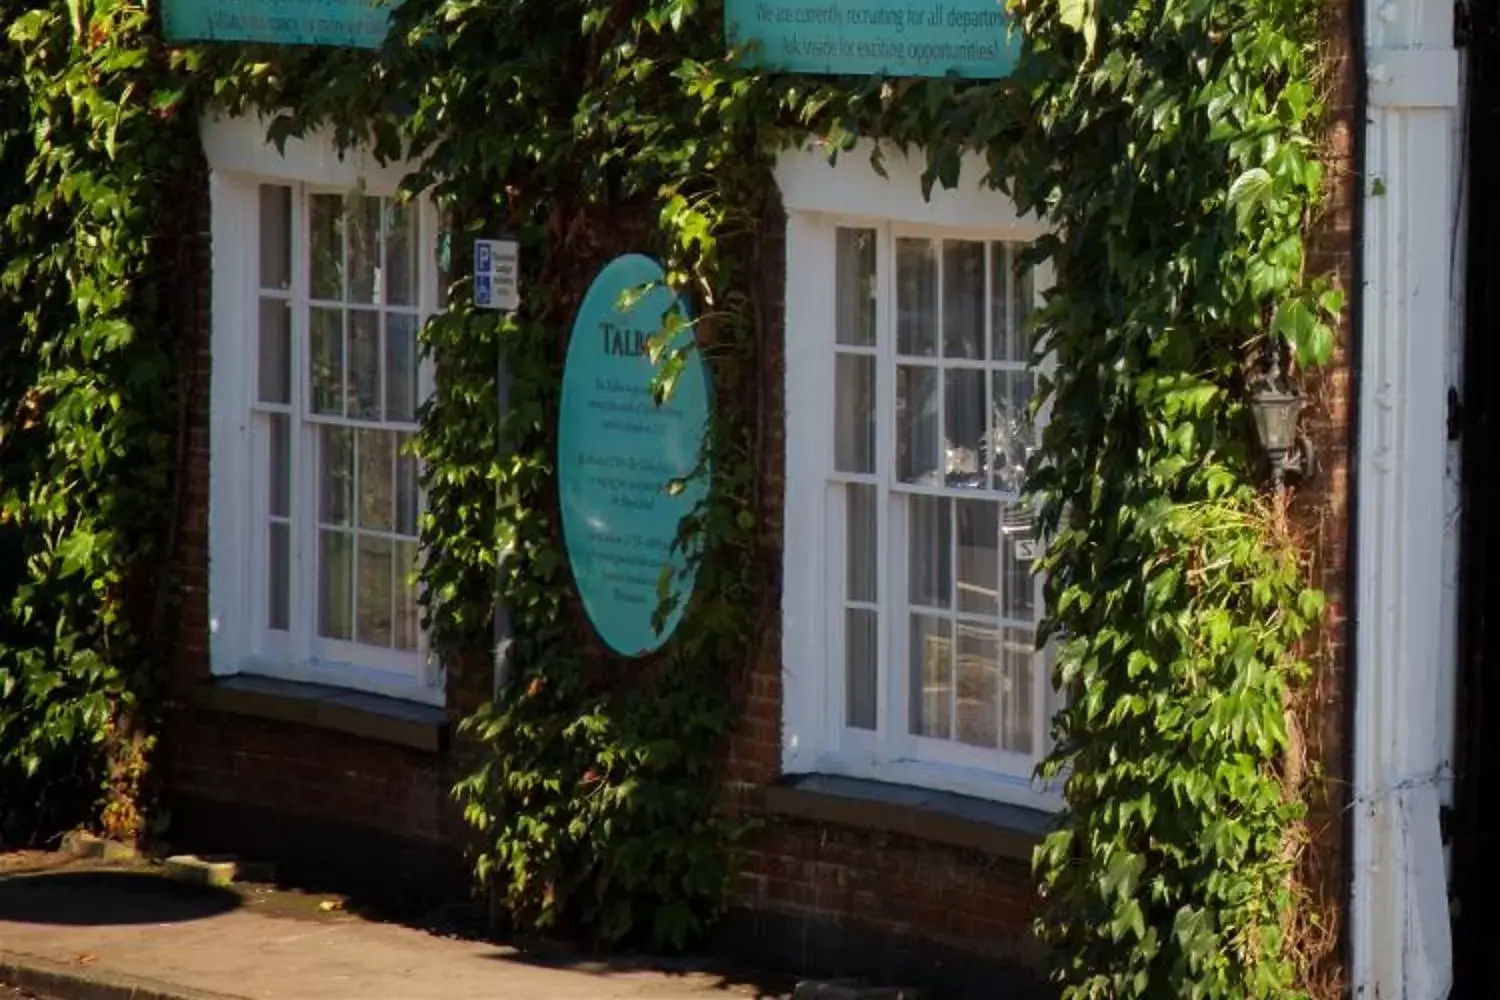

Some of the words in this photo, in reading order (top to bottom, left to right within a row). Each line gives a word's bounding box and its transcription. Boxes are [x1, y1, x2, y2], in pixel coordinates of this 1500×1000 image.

[795, 3, 844, 28] currently
[847, 4, 906, 33] recruiting
[907, 4, 923, 26] for
[927, 2, 943, 26] all
[947, 7, 1004, 34] departm
[480, 247, 489, 268] P
[599, 323, 660, 357] TALB
